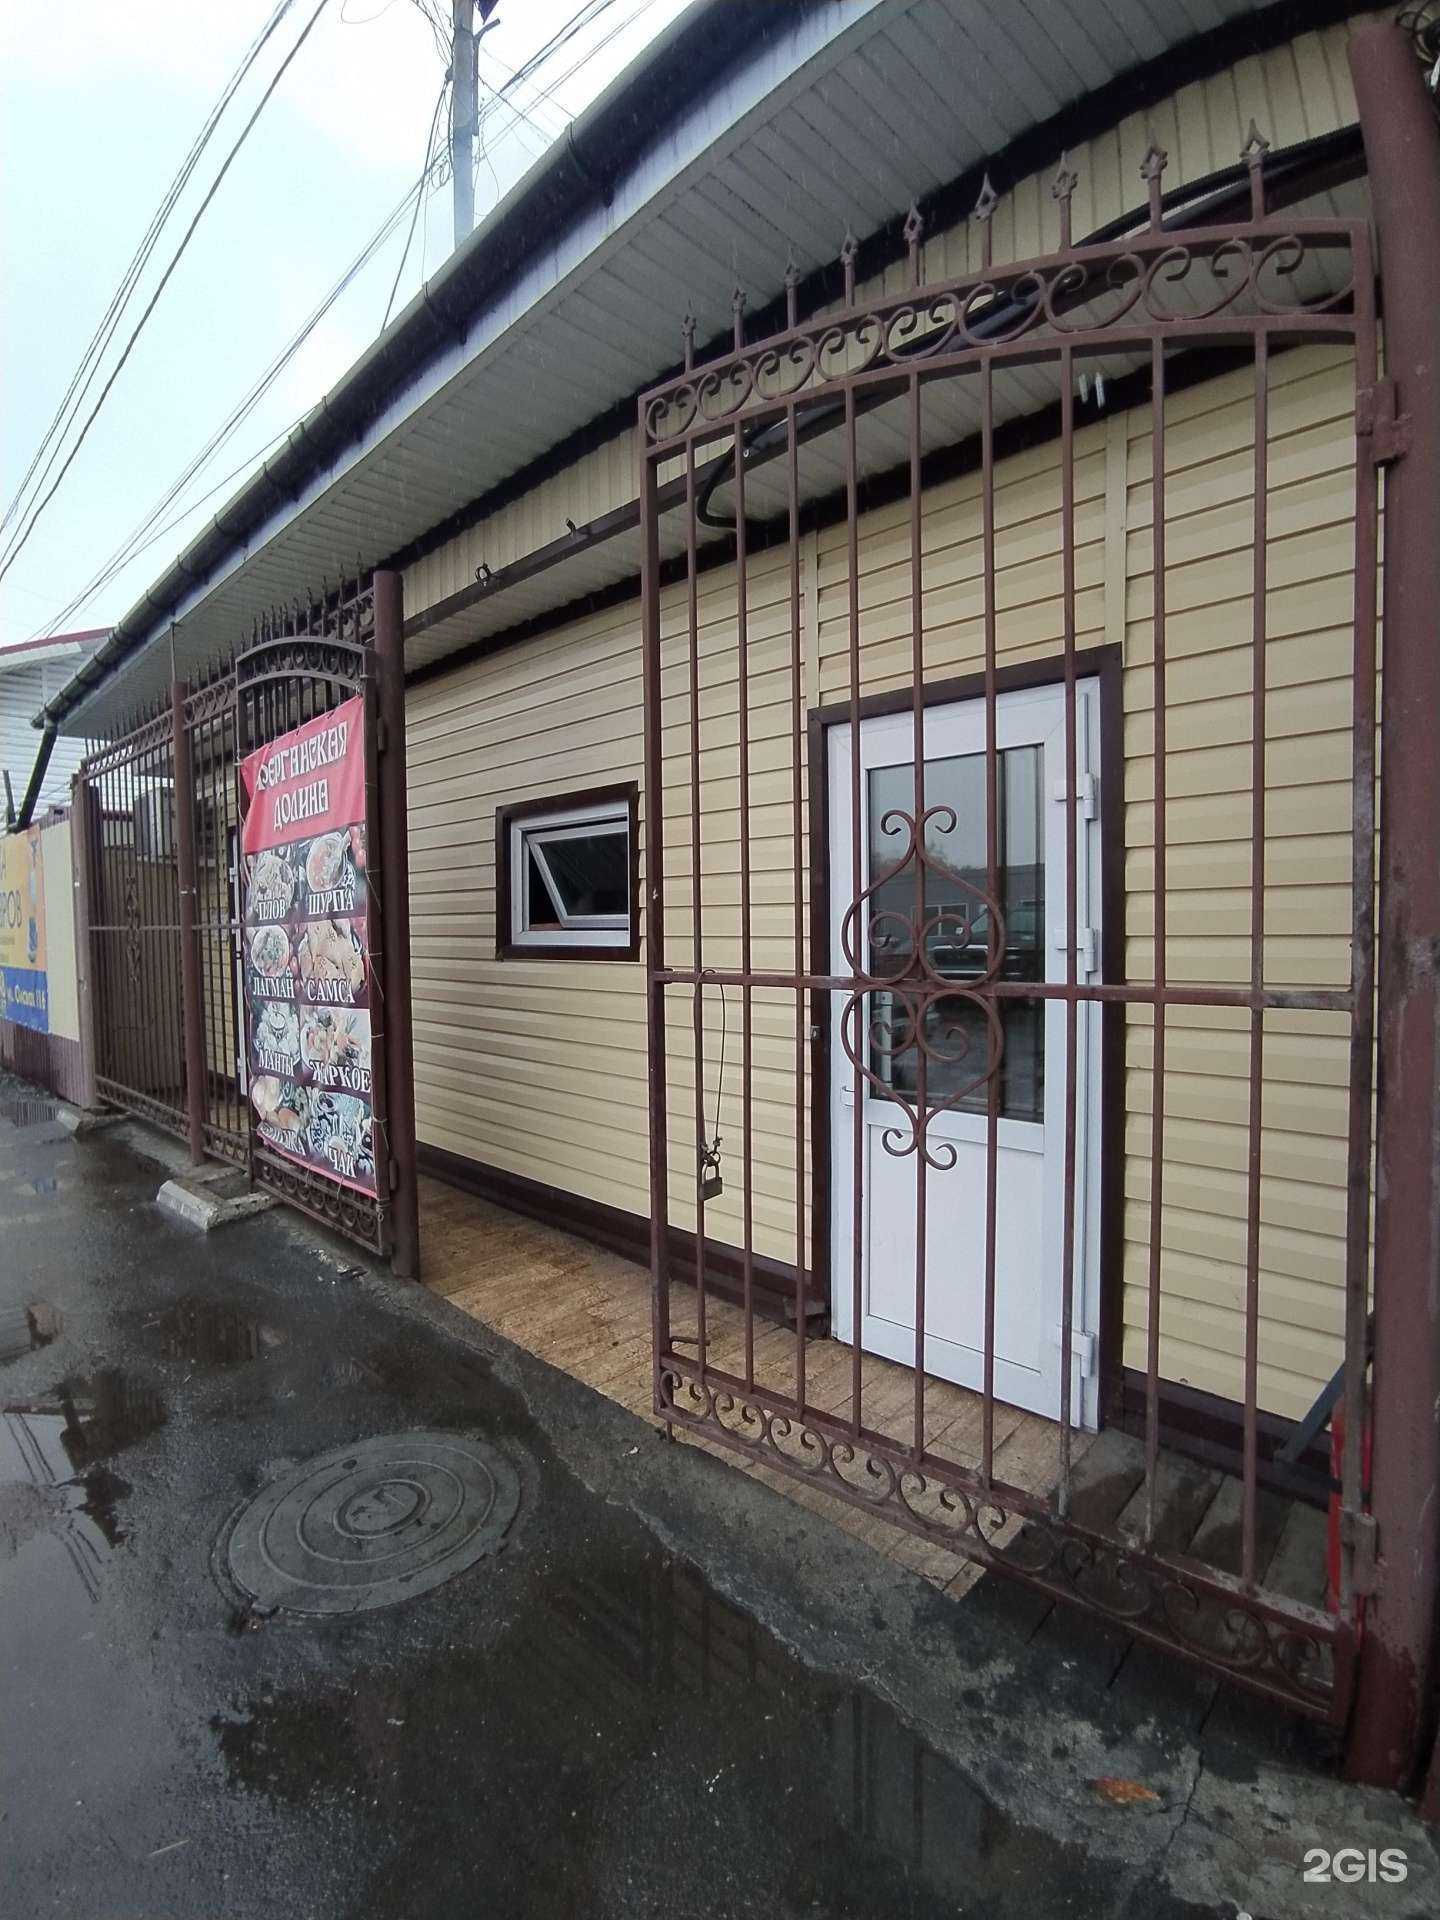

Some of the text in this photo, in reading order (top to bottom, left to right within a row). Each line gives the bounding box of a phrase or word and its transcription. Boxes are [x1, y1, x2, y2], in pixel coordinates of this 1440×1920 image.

[273, 778, 329, 831] ДОЛИНА
[257, 897, 286, 921] ПЛОВ
[308, 889, 354, 915] ШУРПА
[252, 976, 295, 999] ЛАГМАН
[307, 978, 355, 1003] САМСА
[258, 1049, 295, 1077] МАНТЫ
[310, 1060, 372, 1093] ЖАРКОЕ
